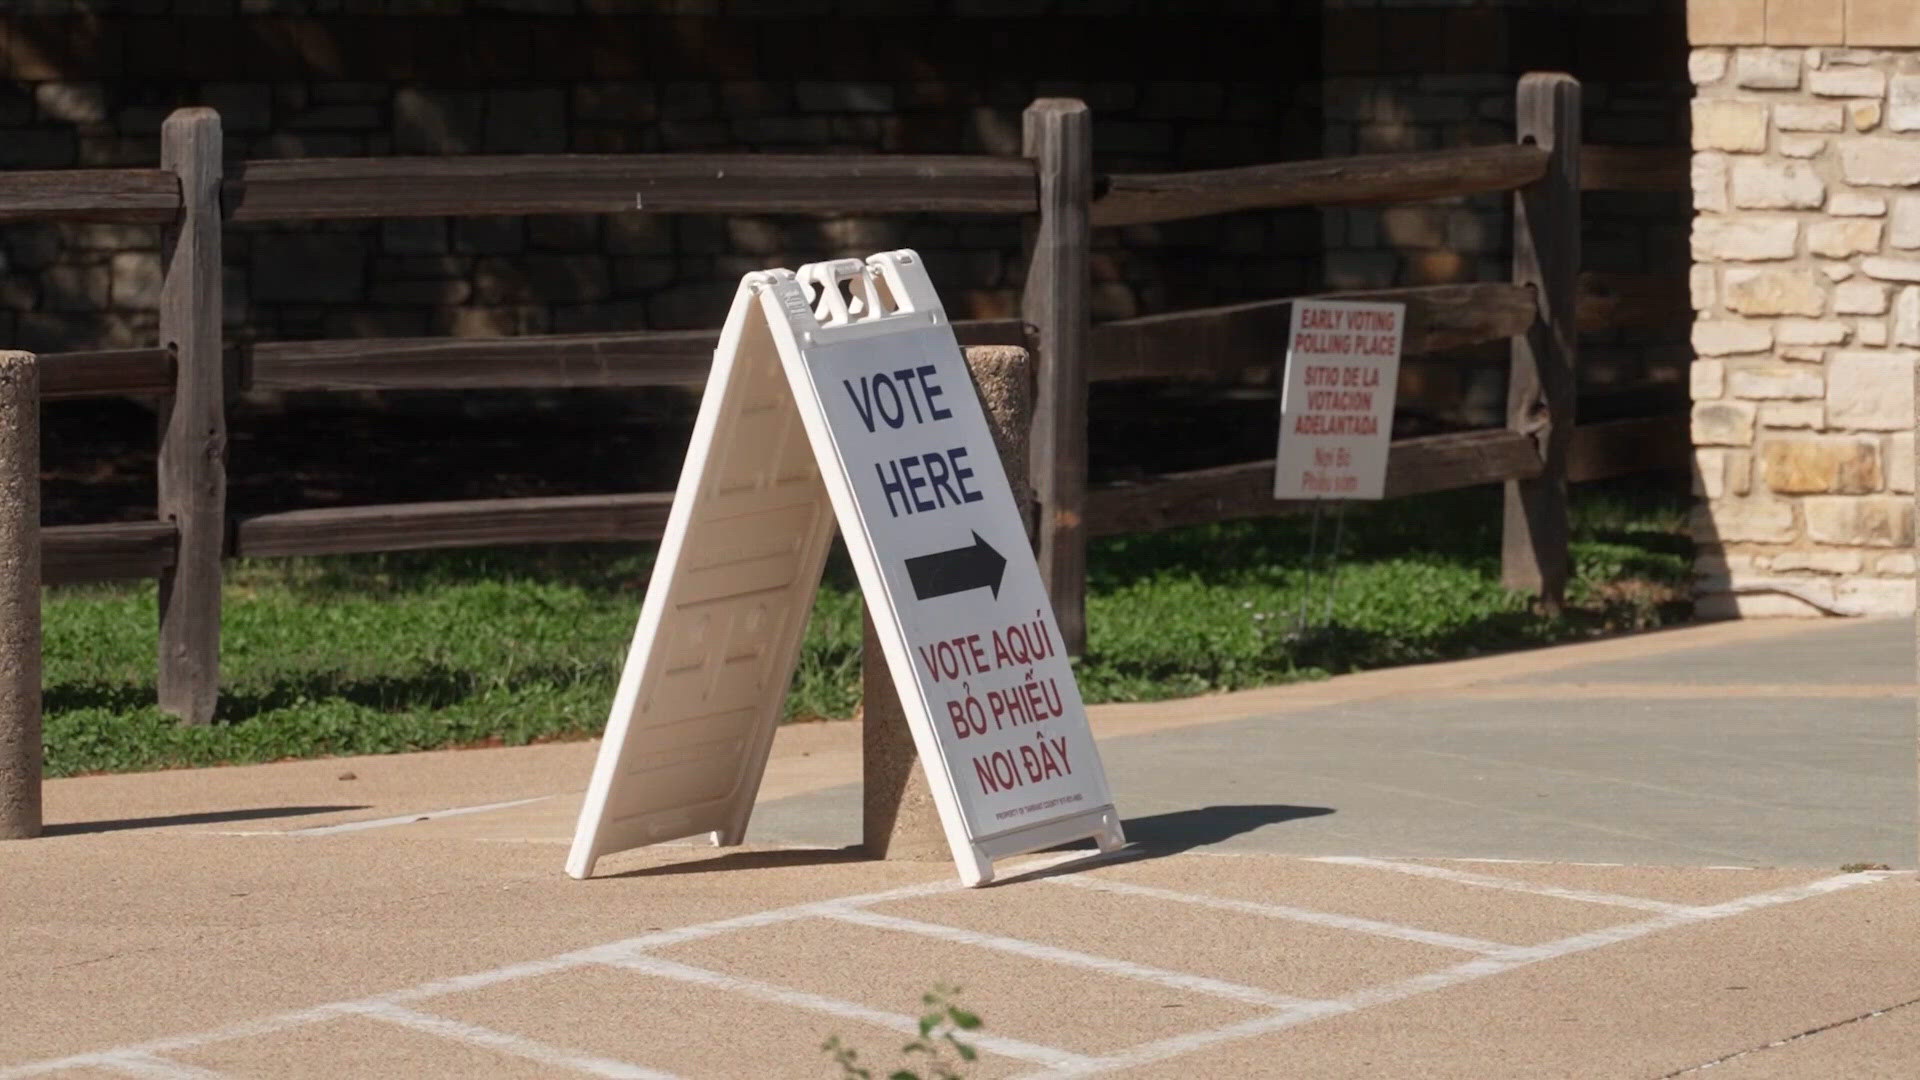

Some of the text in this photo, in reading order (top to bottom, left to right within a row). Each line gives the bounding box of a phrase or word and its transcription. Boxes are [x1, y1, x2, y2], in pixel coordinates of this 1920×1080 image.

[1295, 333, 1396, 356] POLLING PLACE
[1301, 308, 1395, 331] EARLY VOTING
[843, 364, 953, 433] VOTE
[1304, 366, 1379, 387] SITIO DE LA
[1294, 415, 1378, 435] ADELANTADA
[875, 446, 984, 518] HERE
[919, 609, 1054, 683] VOTE AQUÍ
[947, 681, 987, 739] BỎ
[973, 731, 1072, 795] NOI ĐÂY
